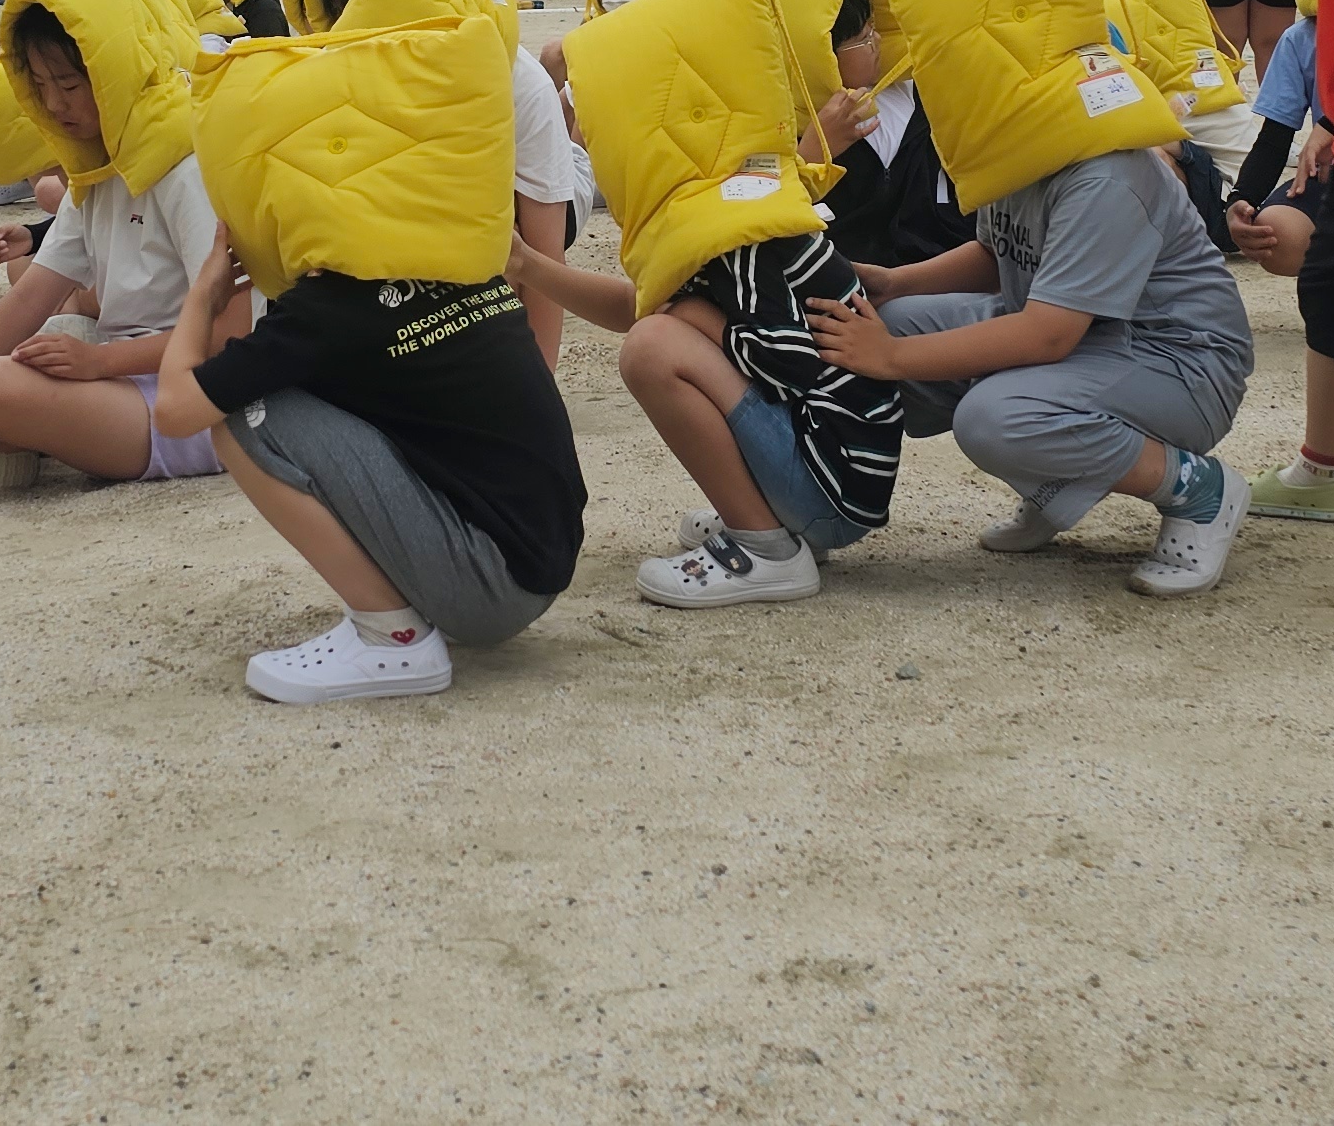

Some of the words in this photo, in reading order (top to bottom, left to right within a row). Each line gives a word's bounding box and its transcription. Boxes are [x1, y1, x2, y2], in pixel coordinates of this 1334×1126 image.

[387, 339, 420, 358] THE
[420, 316, 469, 347] WORLD
[469, 310, 483, 323] IS
[481, 304, 503, 318] JUST
[396, 302, 463, 341] DISCOVER
[461, 294, 484, 307] THE
[480, 287, 501, 301] NEW
